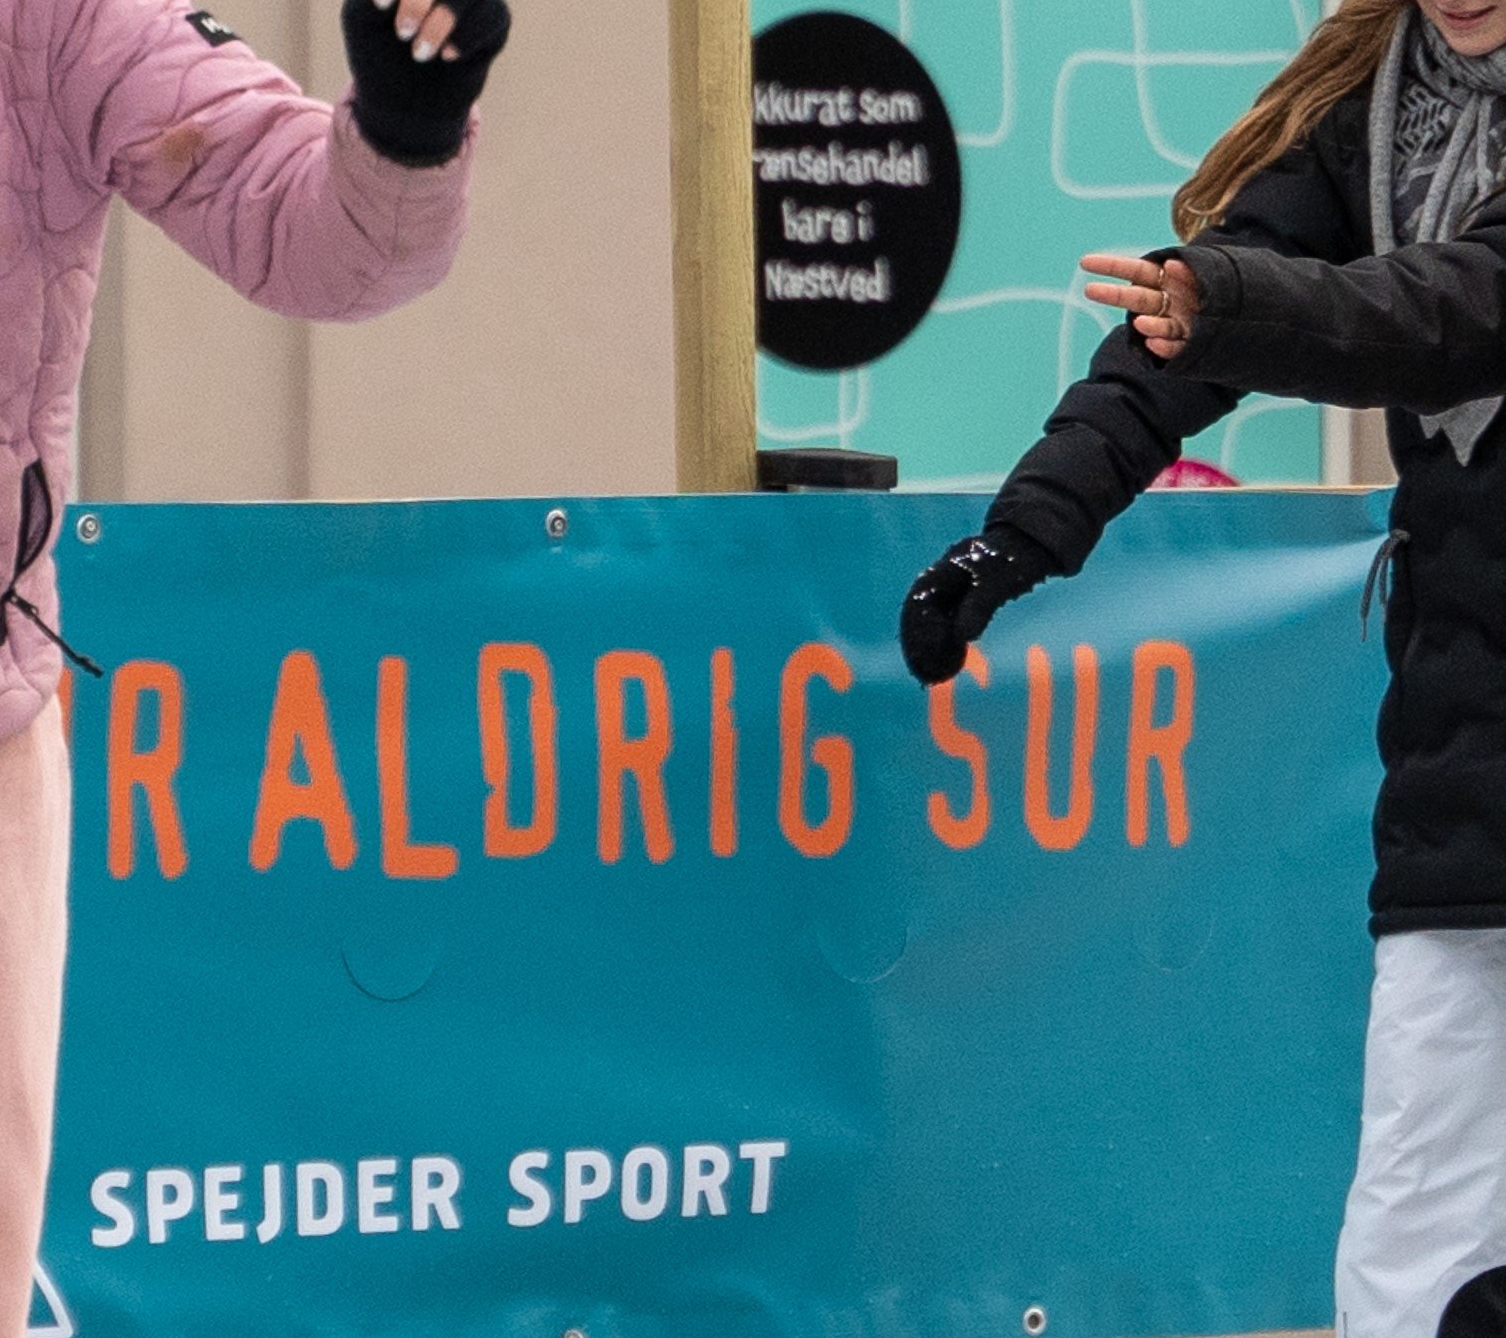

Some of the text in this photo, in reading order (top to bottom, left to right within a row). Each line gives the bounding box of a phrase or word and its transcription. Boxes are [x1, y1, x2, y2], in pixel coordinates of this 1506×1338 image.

[753, 80, 923, 127] kkurat som
[752, 140, 931, 187] ænsehandel
[781, 197, 875, 244] bare i
[764, 255, 893, 303] Næstved
[249, 640, 858, 881] ALDRIG
[926, 637, 1197, 852] SUR
[89, 1139, 788, 1250] SPEJDER SPORT
